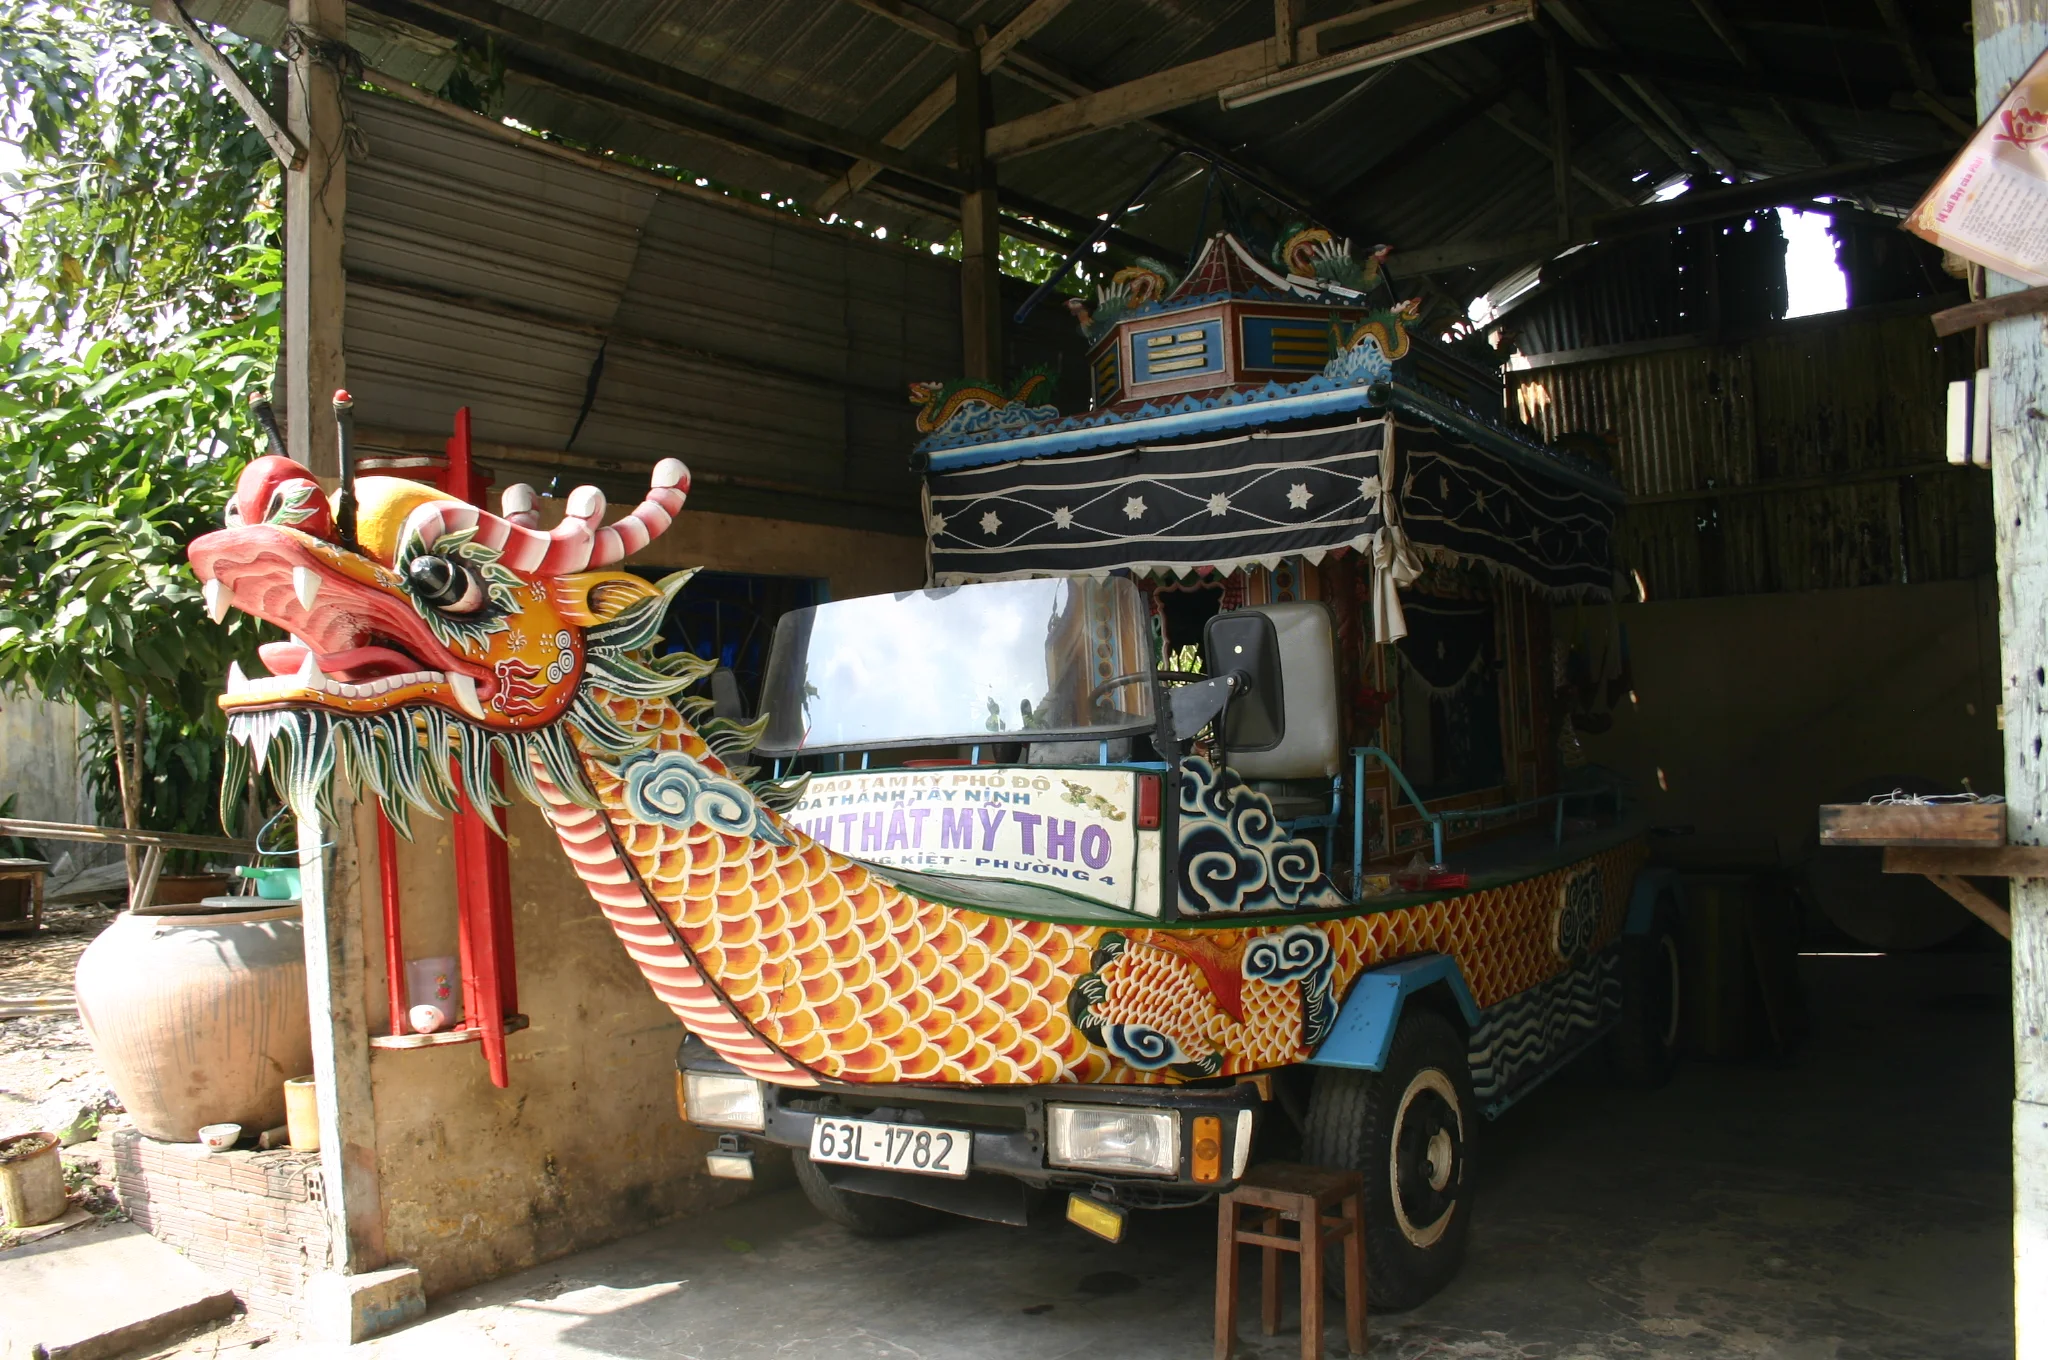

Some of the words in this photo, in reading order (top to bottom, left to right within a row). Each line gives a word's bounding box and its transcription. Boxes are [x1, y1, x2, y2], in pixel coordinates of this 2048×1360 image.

[796, 798, 822, 811] ÒA
[913, 787, 957, 801] TÂY
[941, 801, 1007, 852] MỸ
[1012, 810, 1112, 870] THO
[975, 857, 1091, 882] PHƯỜNG
[1098, 875, 1116, 886] 4
[819, 1121, 954, 1171] 63L-1782
